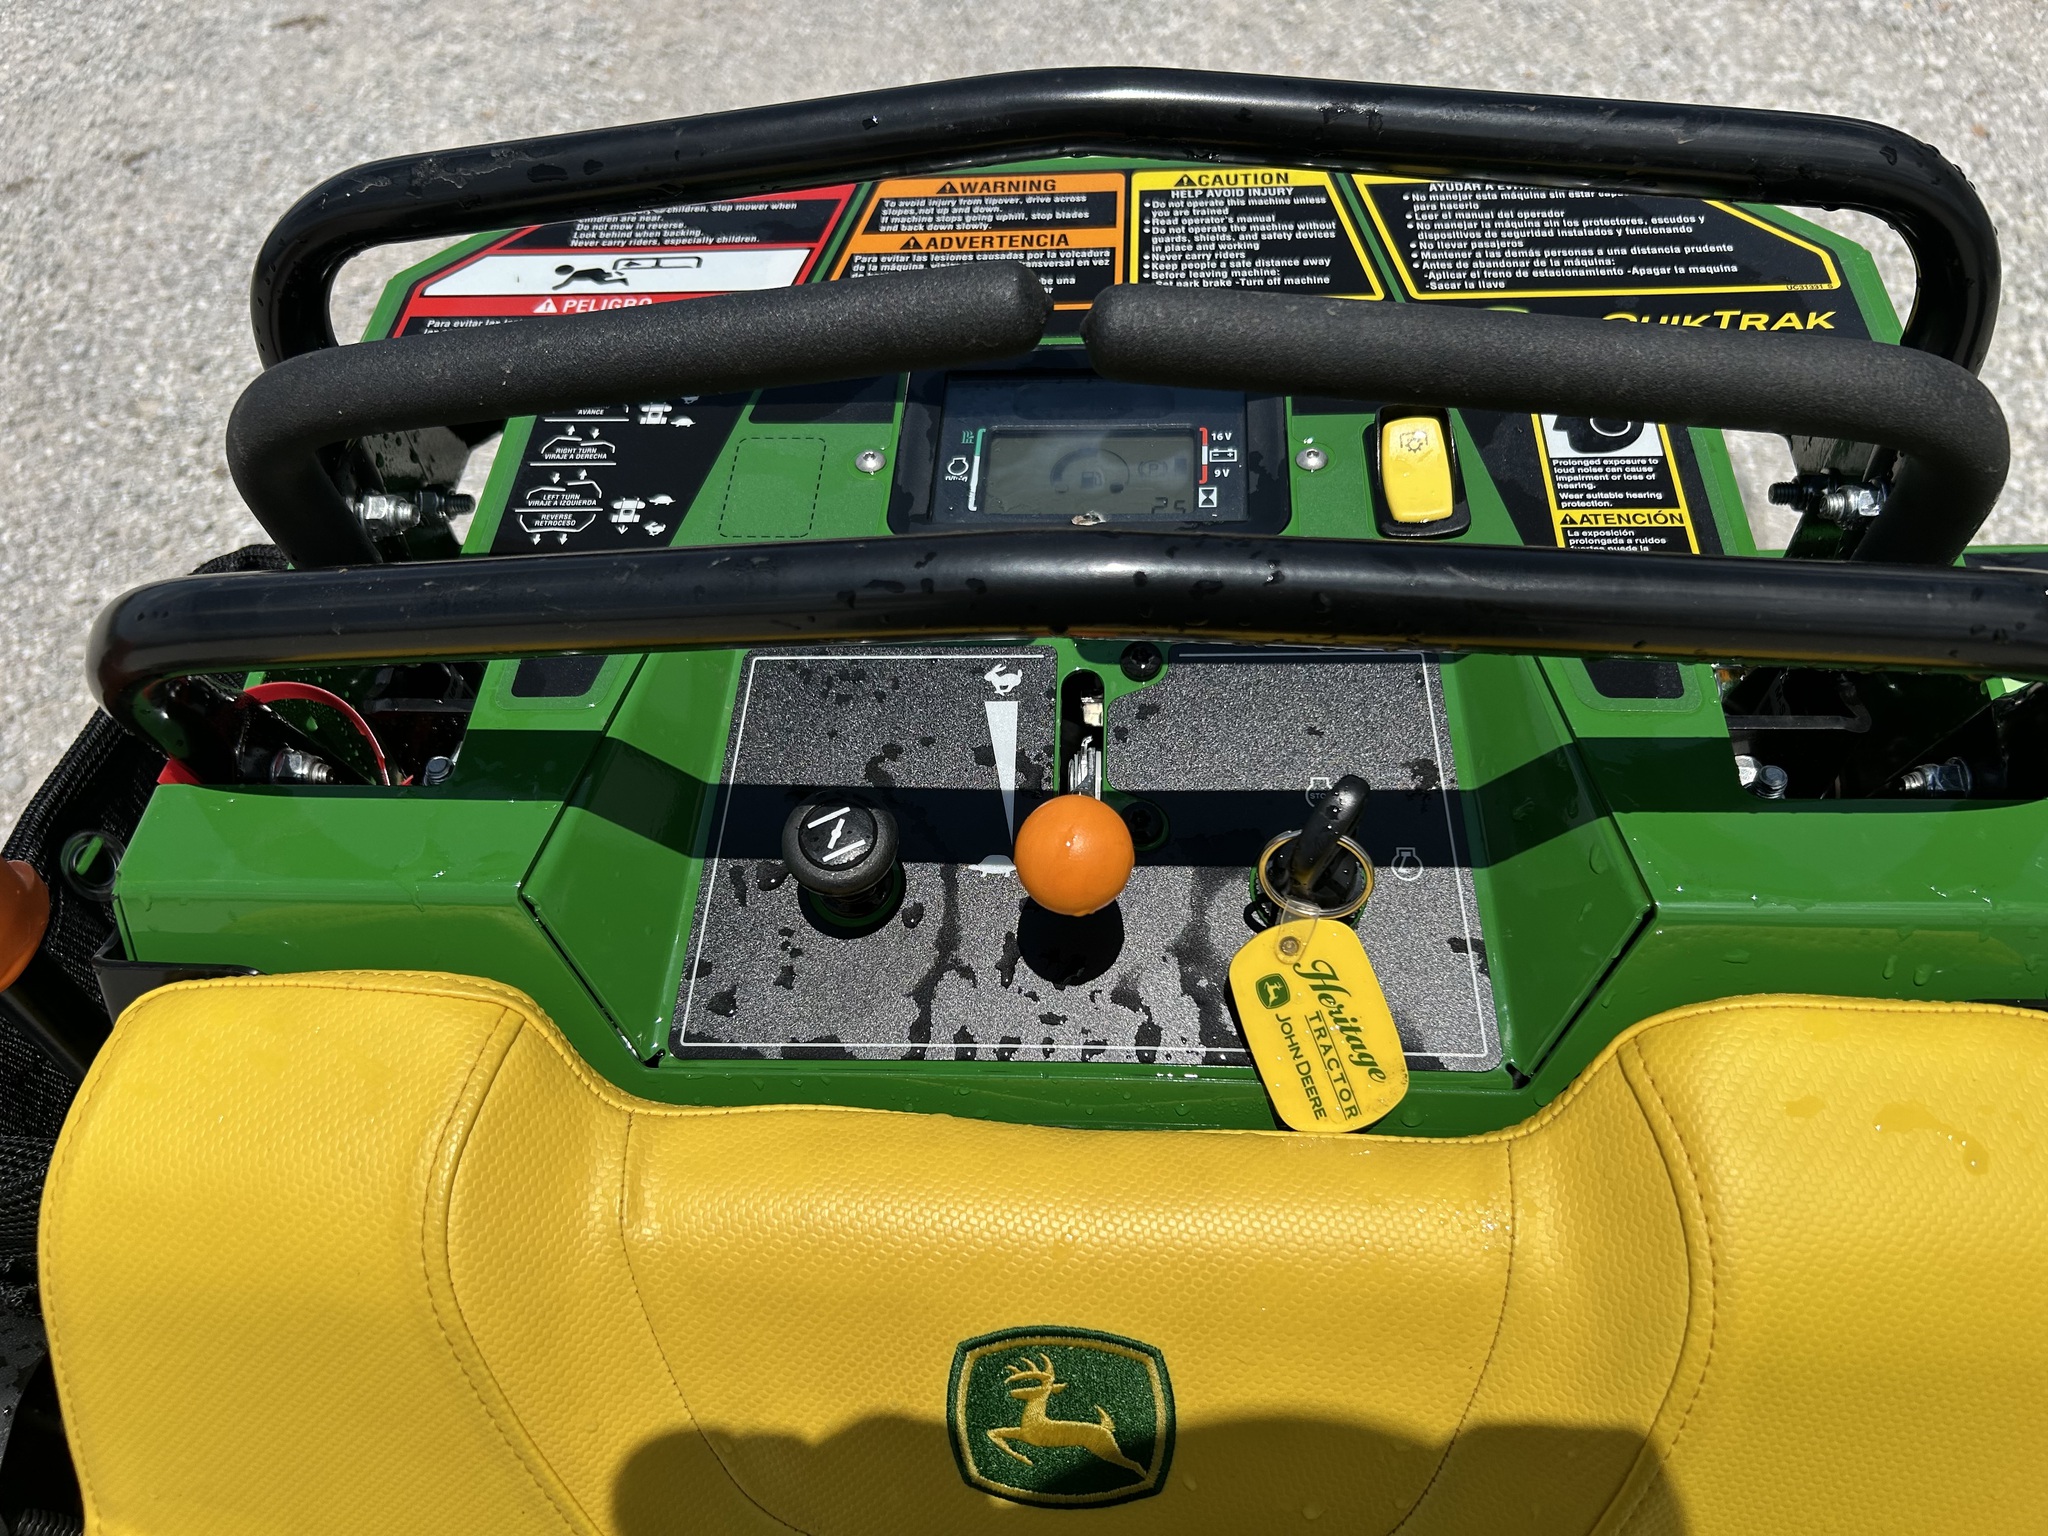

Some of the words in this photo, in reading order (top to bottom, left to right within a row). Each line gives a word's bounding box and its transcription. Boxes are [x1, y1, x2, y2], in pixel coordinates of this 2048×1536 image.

[1198, 172, 1289, 187] CAUTION
[960, 179, 1056, 193] WARNING
[1171, 189, 1203, 199] HELP
[1206, 188, 1244, 198] AVOID
[1248, 187, 1294, 197] INJURY
[898, 199, 926, 207] avoid
[928, 198, 957, 208] injury
[958, 197, 982, 205] from
[984, 196, 1022, 206] tipover,
[1025, 196, 1051, 204] drive
[1152, 200, 1166, 208] Do
[1168, 200, 1184, 208] not
[1186, 199, 1224, 209] operate
[1226, 198, 1245, 206] this
[1248, 197, 1290, 206] machine
[1293, 196, 1327, 205] unless
[666, 205, 708, 215] children,
[712, 204, 733, 214] stop
[770, 202, 797, 210] when
[1415, 212, 1438, 220] Leer
[1441, 212, 1451, 220] el
[1455, 211, 1494, 220] manual
[1497, 210, 1514, 219] del
[1517, 209, 1566, 220] operador
[1152, 217, 1178, 225] Read
[1181, 215, 1234, 226] operator's
[1236, 214, 1276, 223] manual
[663, 229, 704, 239] backing.
[1152, 226, 1166, 234] Do
[1168, 225, 1185, 234] not
[1188, 224, 1227, 235] operate
[1230, 224, 1246, 232] the
[1249, 223, 1294, 232] machine
[1296, 222, 1336, 231] without
[570, 239, 599, 247] Never
[601, 240, 626, 248] carry
[628, 237, 660, 247] riders,
[664, 236, 714, 246] especially
[716, 235, 760, 244] children.
[926, 234, 1069, 250] ADVERTENCIA
[1419, 241, 1434, 249] No
[1436, 240, 1467, 249] llevar
[1470, 239, 1524, 250] pasajeros
[854, 254, 878, 262] Para
[880, 253, 910, 262] evitar
[912, 253, 928, 261] las
[930, 252, 973, 261] lesiones
[976, 251, 1024, 260] causadas
[1026, 252, 1044, 261] por
[1046, 250, 1057, 258] la
[1059, 249, 1110, 258] volcadura
[1152, 252, 1182, 261] Never
[1185, 253, 1212, 262] carry
[1214, 250, 1246, 259] riders
[1420, 250, 1472, 260] Mantener
[1485, 249, 1501, 258] las
[1504, 248, 1541, 257] demás
[1544, 249, 1594, 258] personas
[1630, 245, 1680, 254] distancia
[1684, 244, 1734, 255] prudente
[1152, 261, 1178, 272] Keep
[1181, 260, 1216, 271] people
[1229, 260, 1252, 268] safe
[1255, 258, 1299, 268] distance
[1303, 260, 1331, 268] away
[1422, 260, 1452, 269] Antes
[1455, 260, 1469, 268] de
[1472, 259, 1530, 268] abandonar
[1533, 258, 1546, 267] de
[1549, 258, 1560, 266] la
[1563, 257, 1616, 268] máquina:
[1152, 270, 1186, 279] Before
[1189, 269, 1228, 280] leaving
[1231, 268, 1280, 277] machine:
[1424, 270, 1466, 281] -Aplicar
[1470, 270, 1480, 278] el
[1483, 269, 1512, 278] freno
[1515, 269, 1528, 277] de
[1532, 267, 1624, 277] estacionamiento
[1627, 266, 1671, 277] -Apagar
[1674, 265, 1685, 274] la
[1688, 264, 1738, 275] maquina
[1426, 281, 1461, 290] -Sacar
[1464, 280, 1474, 289] la
[1478, 280, 1506, 289] llave
[1211, 432, 1224, 441] 16
[1223, 432, 1232, 441] V
[1553, 458, 1601, 467] Prolonged
[1214, 469, 1222, 477] 9
[1221, 469, 1230, 477] V
[1556, 474, 1609, 483] impairment
[1557, 482, 1596, 490] hearing.
[1625, 492, 1663, 500] hearing
[1561, 500, 1613, 509] protection.
[1579, 510, 1684, 525] ATENCIÓN
[1581, 529, 1635, 538] exposición
[1569, 537, 1624, 546] prolongada
[1292, 959, 1386, 1084] Heritage
[1276, 1013, 1304, 1061] JOHN
[1295, 1062, 1328, 1121] DEERE
[1308, 1010, 1359, 1119] TRACTOR
